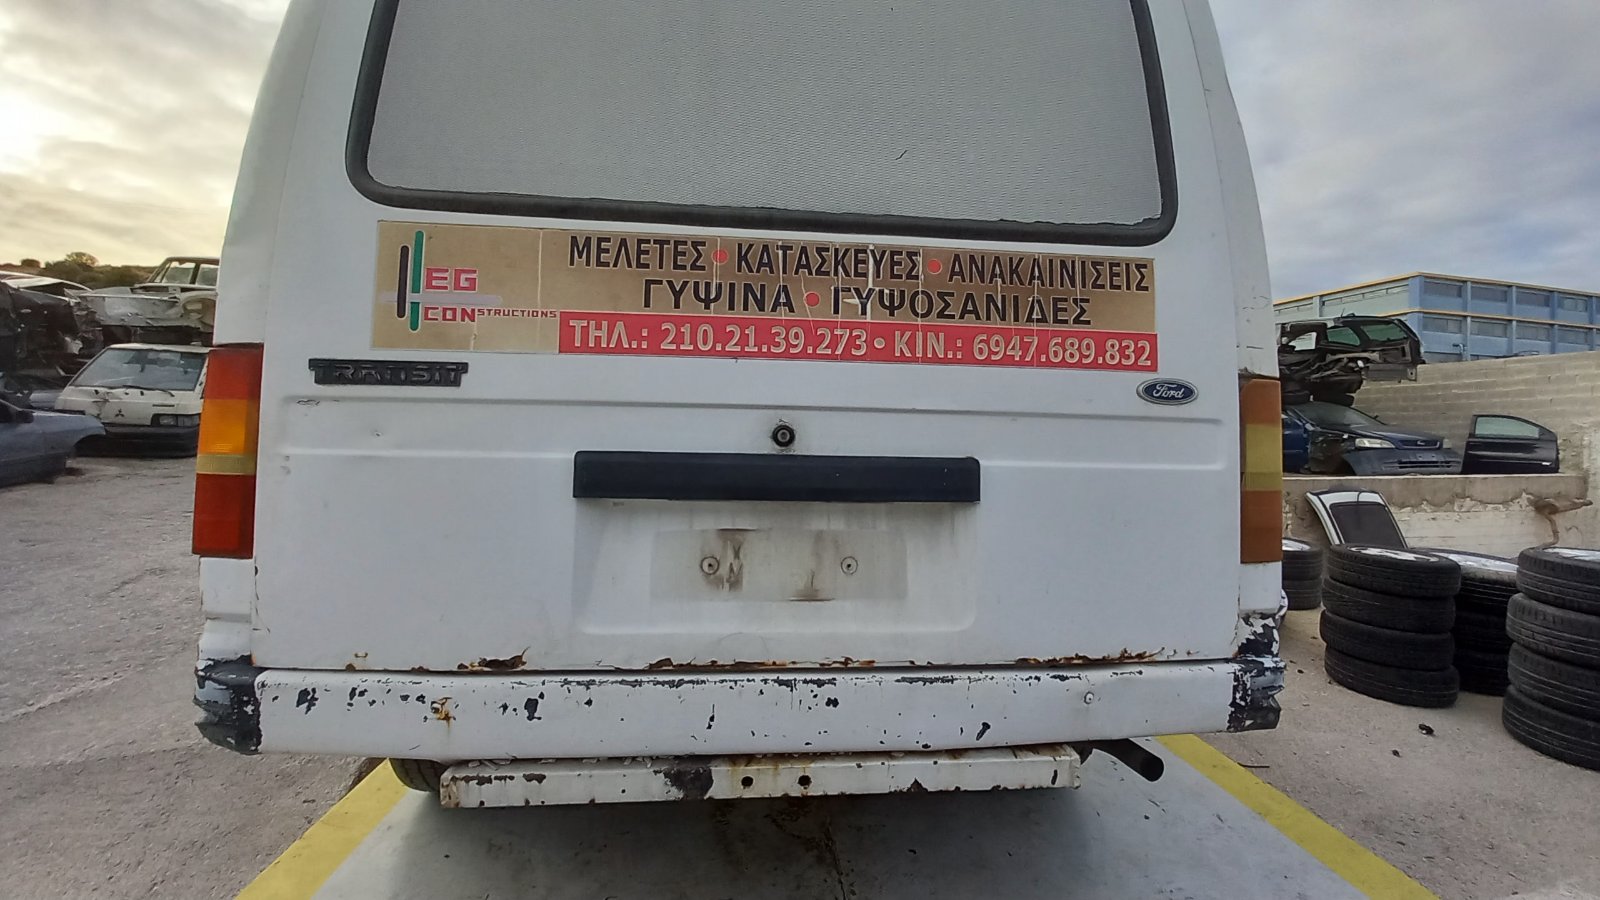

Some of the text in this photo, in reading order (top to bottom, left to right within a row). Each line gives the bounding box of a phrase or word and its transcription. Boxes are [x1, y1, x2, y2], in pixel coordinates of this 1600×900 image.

[569, 235, 1150, 292] ΜΕΛΕΤΕΣ ΚΑΤΑΣΚΕΥΕΣ ΑΝΑΚΑΙΝΙΣΕΙΣ
[423, 305, 558, 323] CONSTRUCTIONS
[643, 279, 1092, 326] ΓΥΨΙΝΑ ΓΥΨΟΣΑΝΙΔΕΣ
[660, 322, 868, 356] 210.21.39.273
[972, 334, 1152, 367] 6947.689.832
[1152, 382, 1186, 400] Ford
